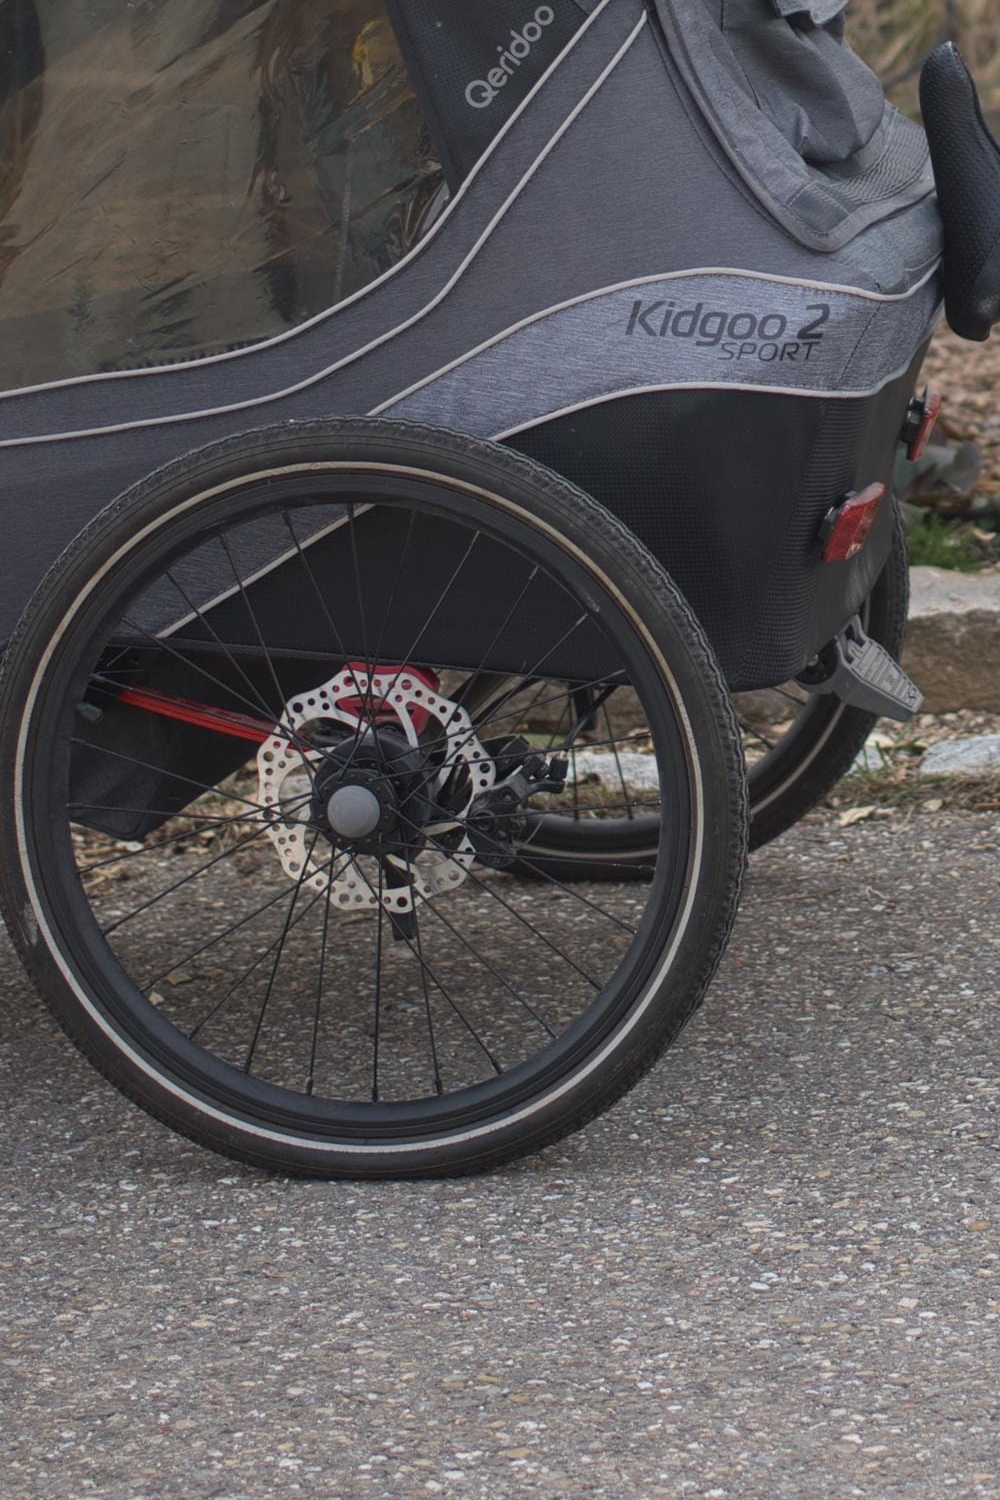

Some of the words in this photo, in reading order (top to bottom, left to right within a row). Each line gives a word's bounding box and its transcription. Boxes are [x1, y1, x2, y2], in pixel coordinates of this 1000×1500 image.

[464, 5, 555, 109] Qeridoo
[624, 300, 788, 347] Kidgoo
[796, 303, 831, 340] 2
[716, 341, 821, 362] SPORT
